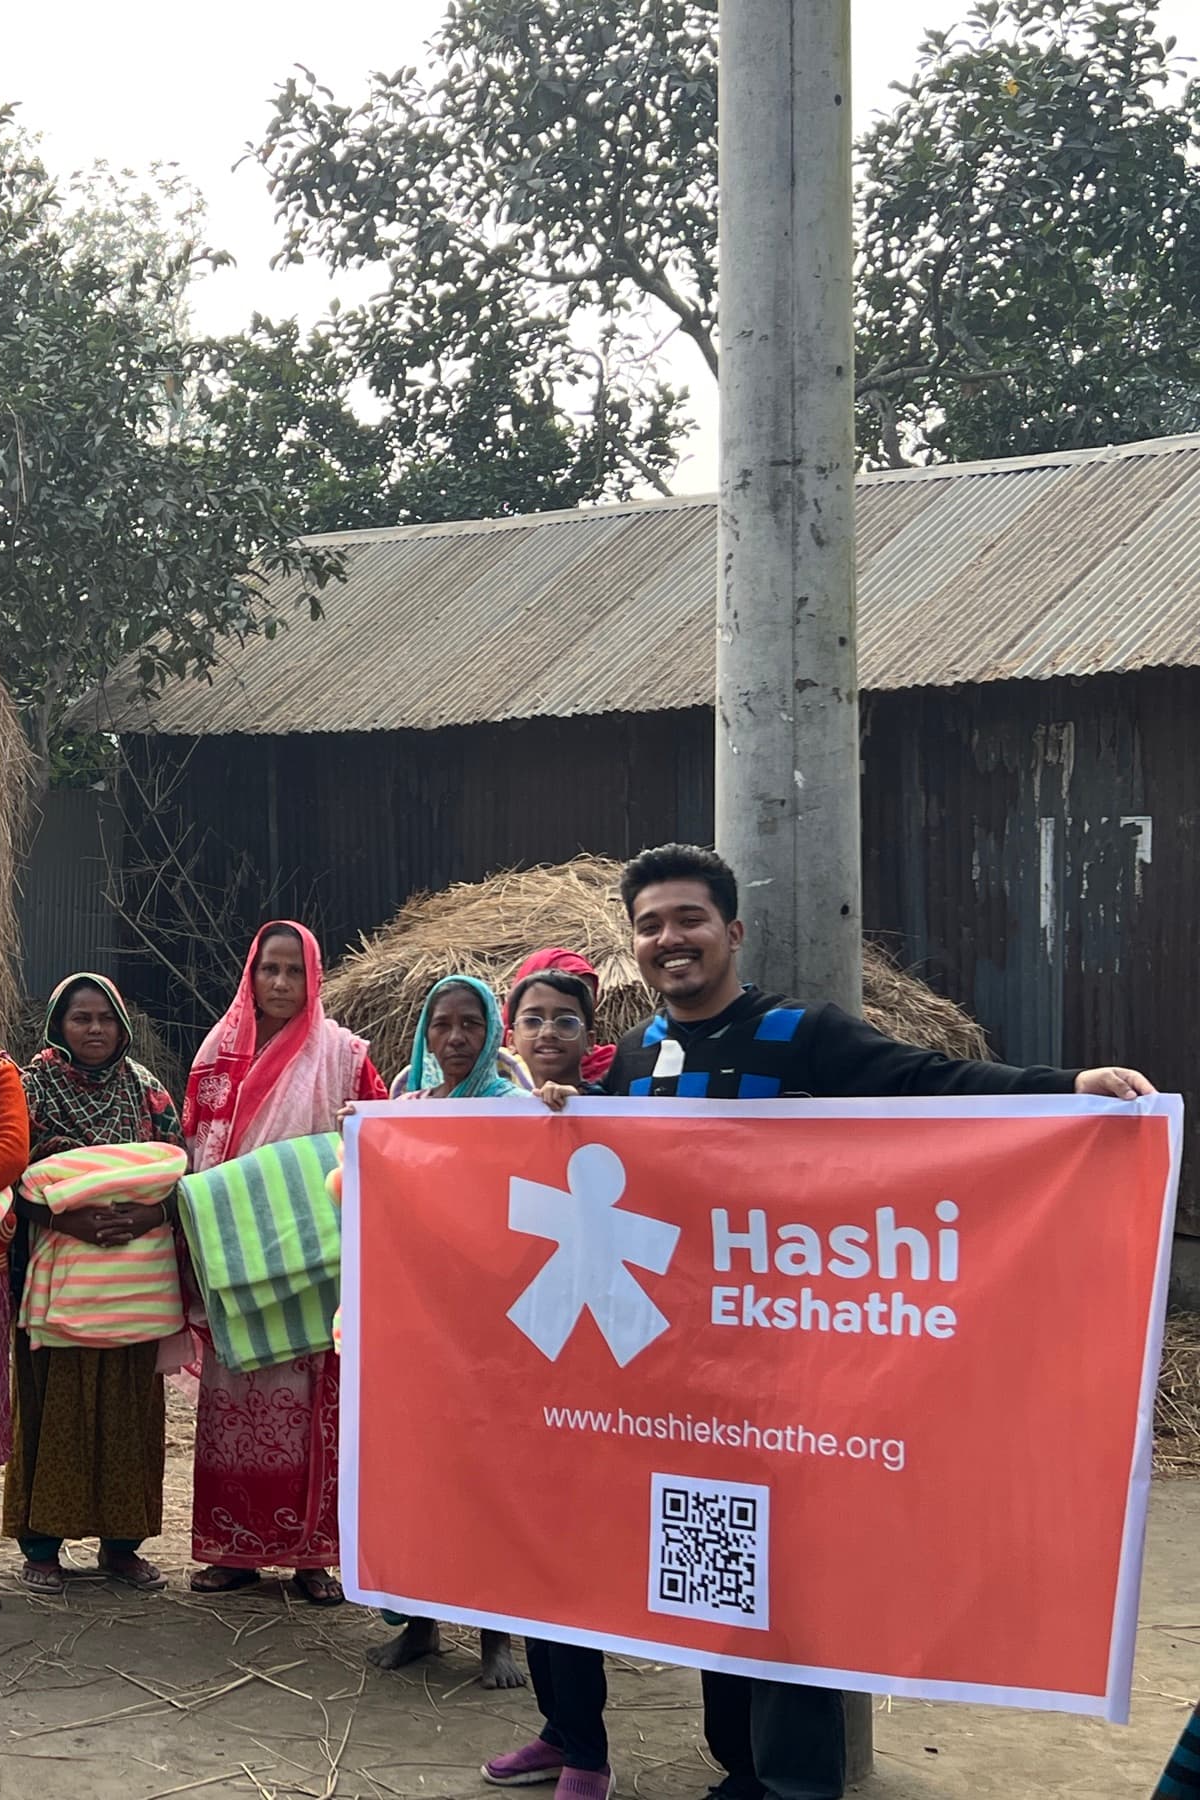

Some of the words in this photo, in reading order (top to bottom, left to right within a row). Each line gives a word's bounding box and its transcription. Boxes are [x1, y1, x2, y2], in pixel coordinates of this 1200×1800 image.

[711, 1200, 959, 1281] Hashi
[711, 1285, 957, 1338] Ekshathe
[543, 1406, 905, 1471] www.hashiekshathe.org
